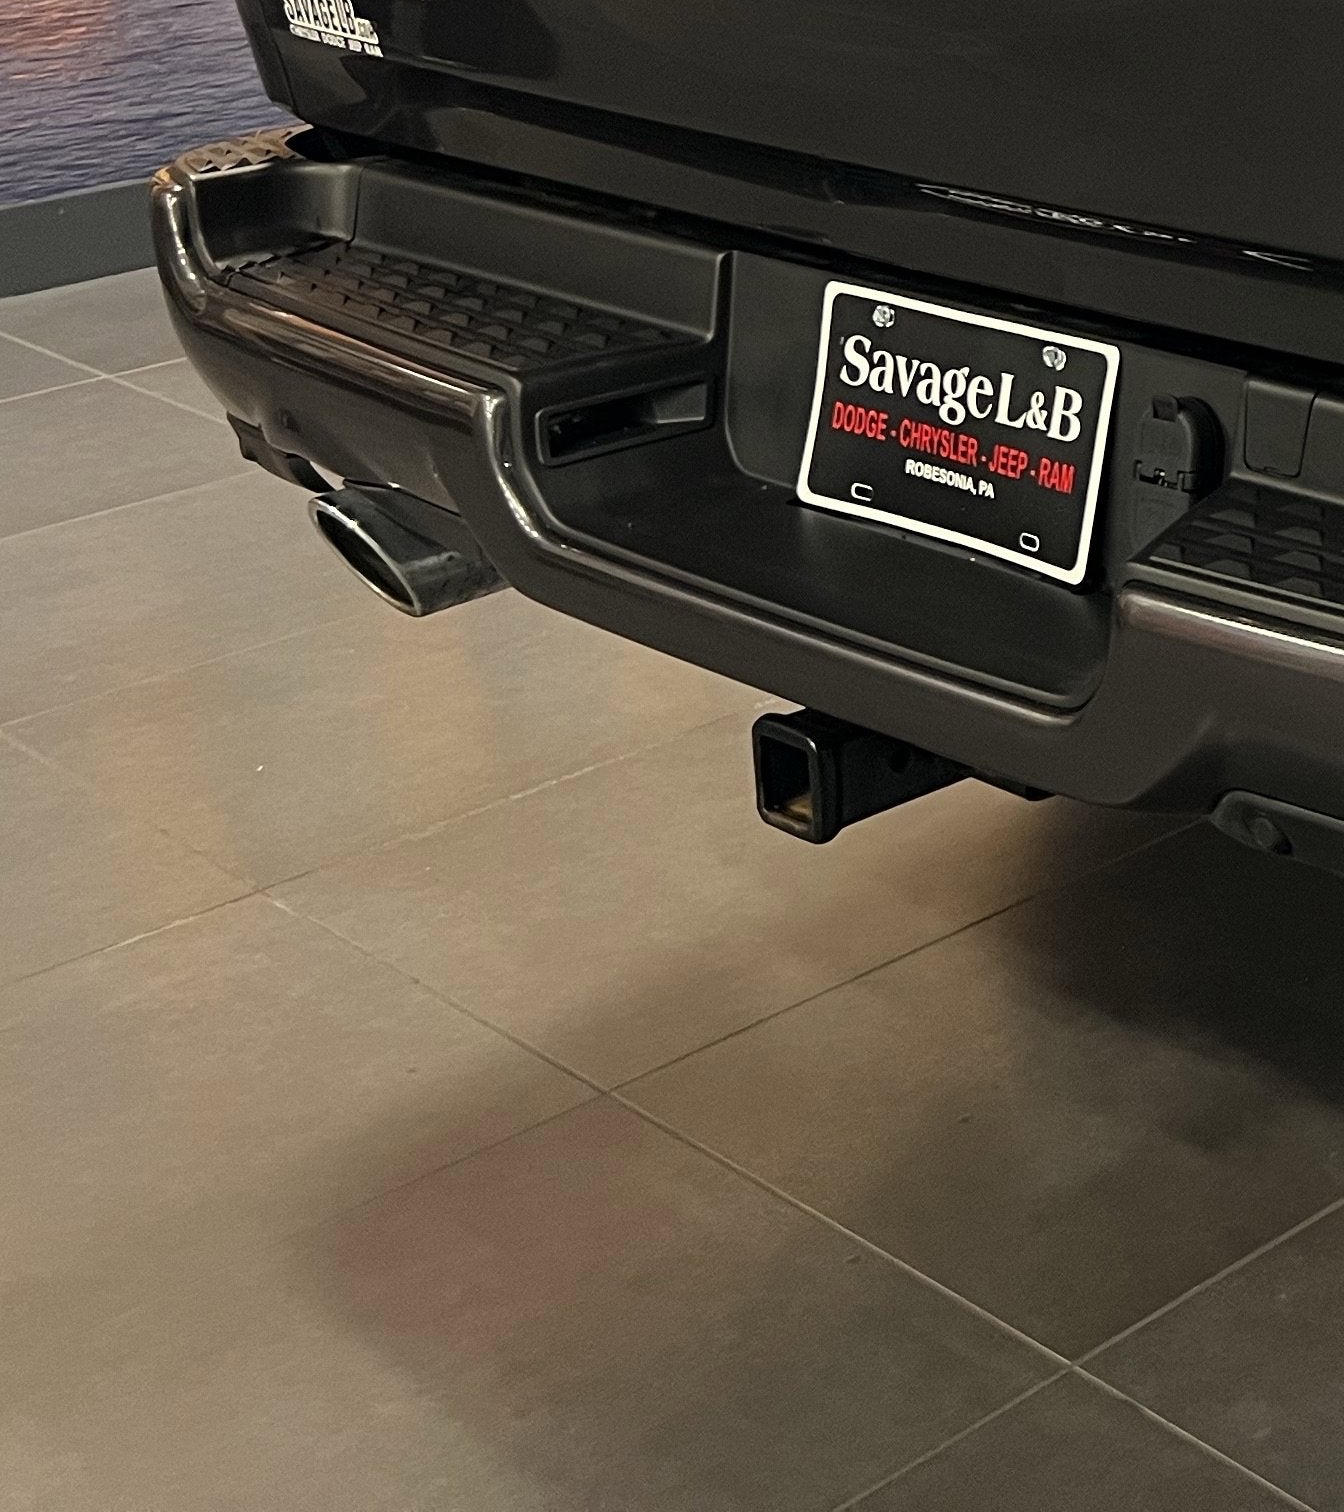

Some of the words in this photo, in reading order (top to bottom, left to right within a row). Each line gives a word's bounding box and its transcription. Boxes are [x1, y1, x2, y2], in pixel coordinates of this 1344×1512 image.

[831, 401, 889, 441] DODGE
[899, 418, 978, 467] CHRYSLER
[988, 444, 1029, 480] JEEP
[1037, 455, 1076, 495] RAM
[904, 458, 978, 496] ROBESONIA,
[977, 479, 996, 500] PA
